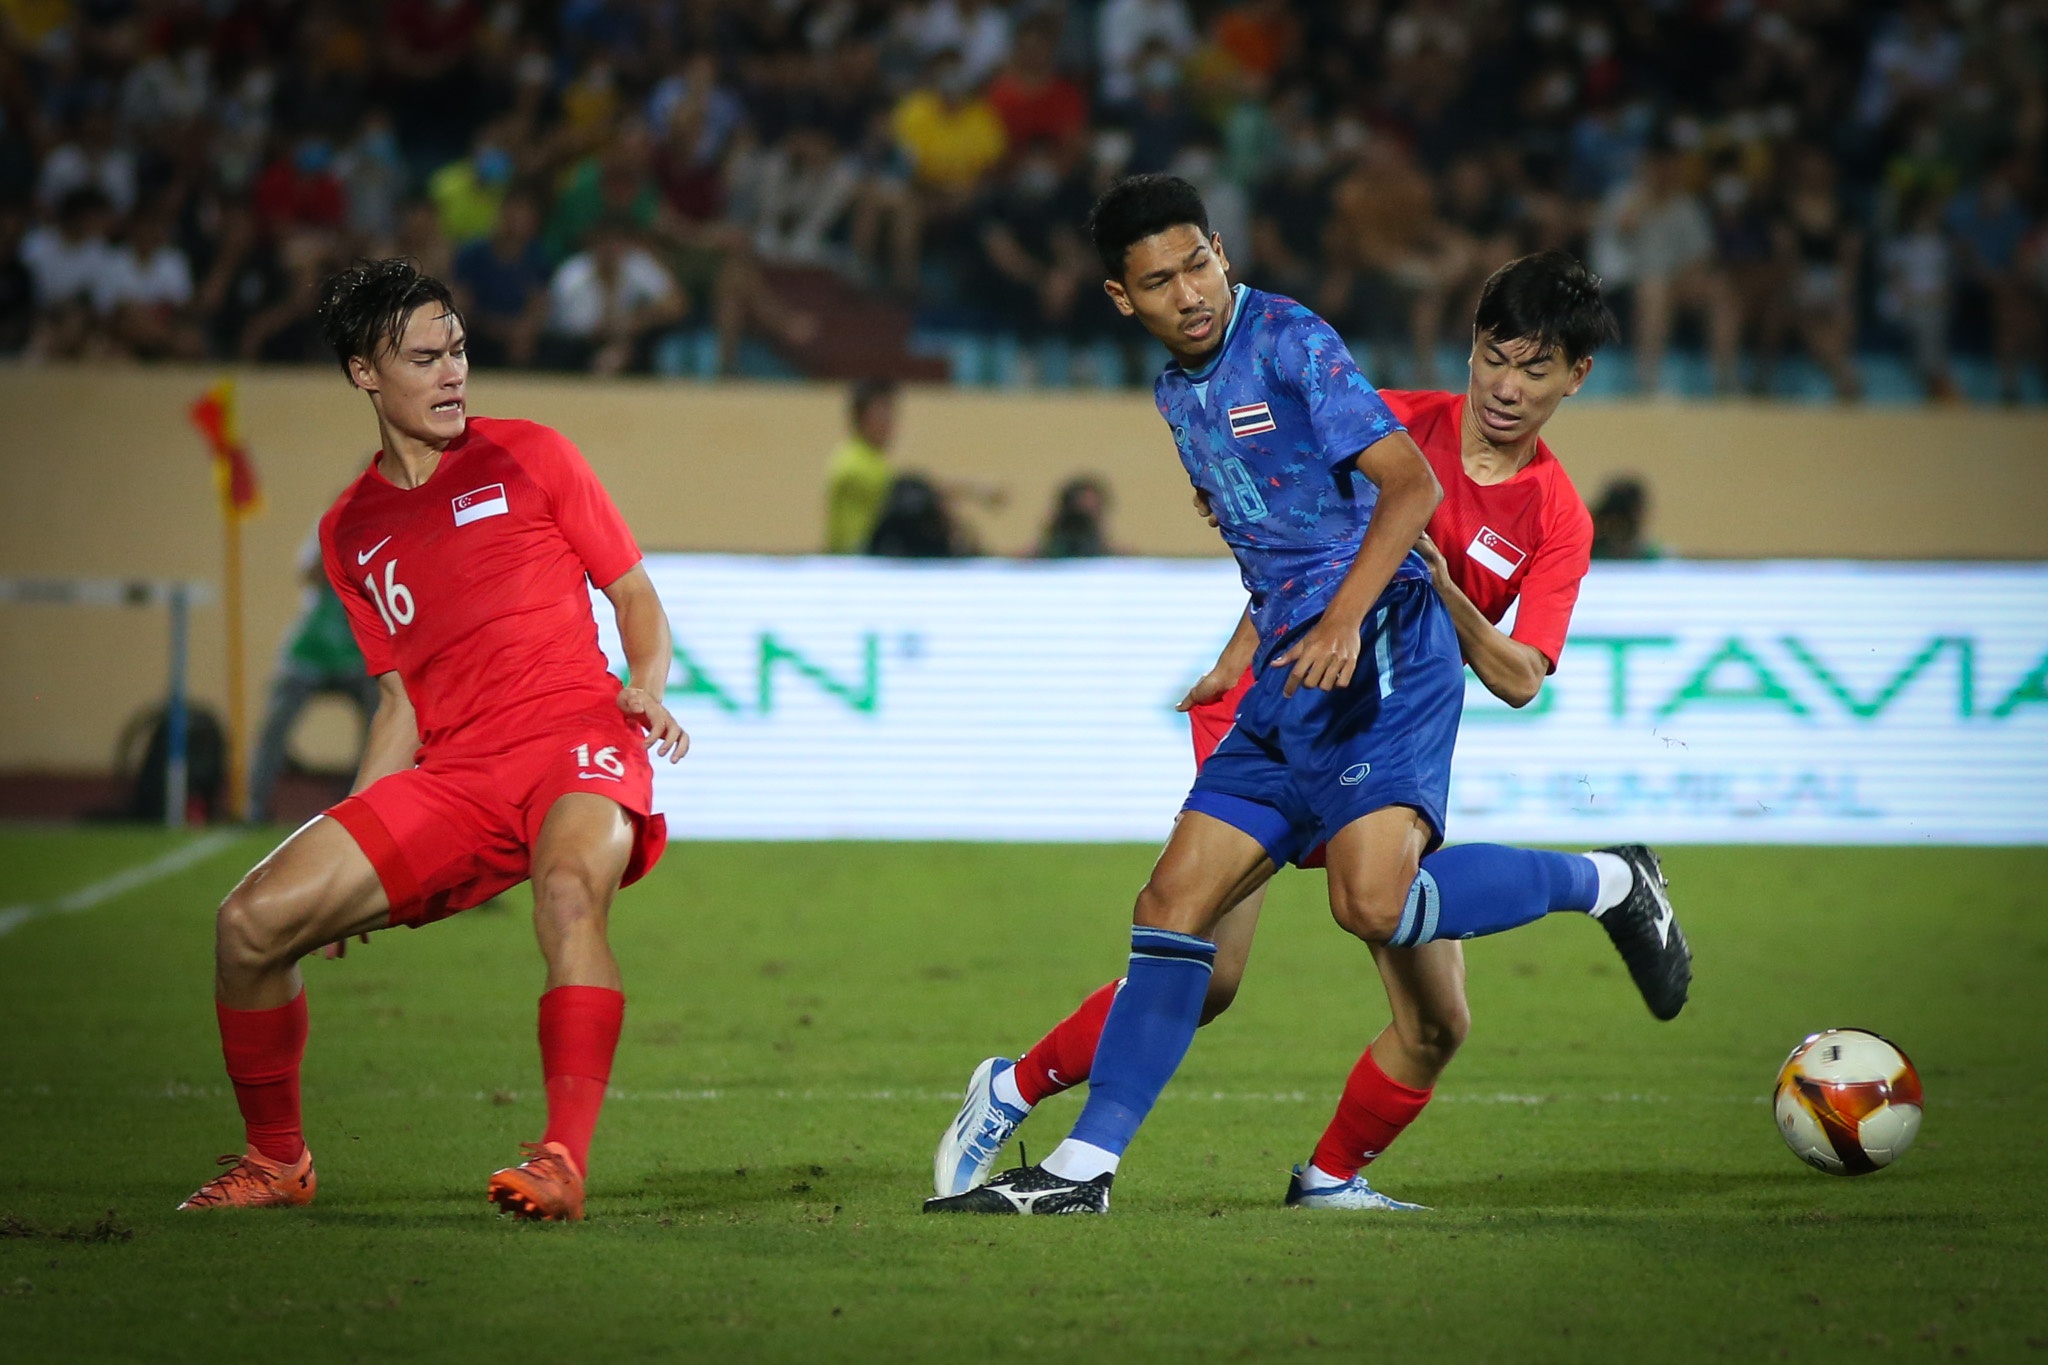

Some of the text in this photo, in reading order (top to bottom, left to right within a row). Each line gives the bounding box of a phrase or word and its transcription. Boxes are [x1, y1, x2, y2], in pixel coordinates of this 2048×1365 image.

[1208, 457, 1268, 526] 18
[364, 559, 415, 635] 16
[570, 743, 624, 777] 16
